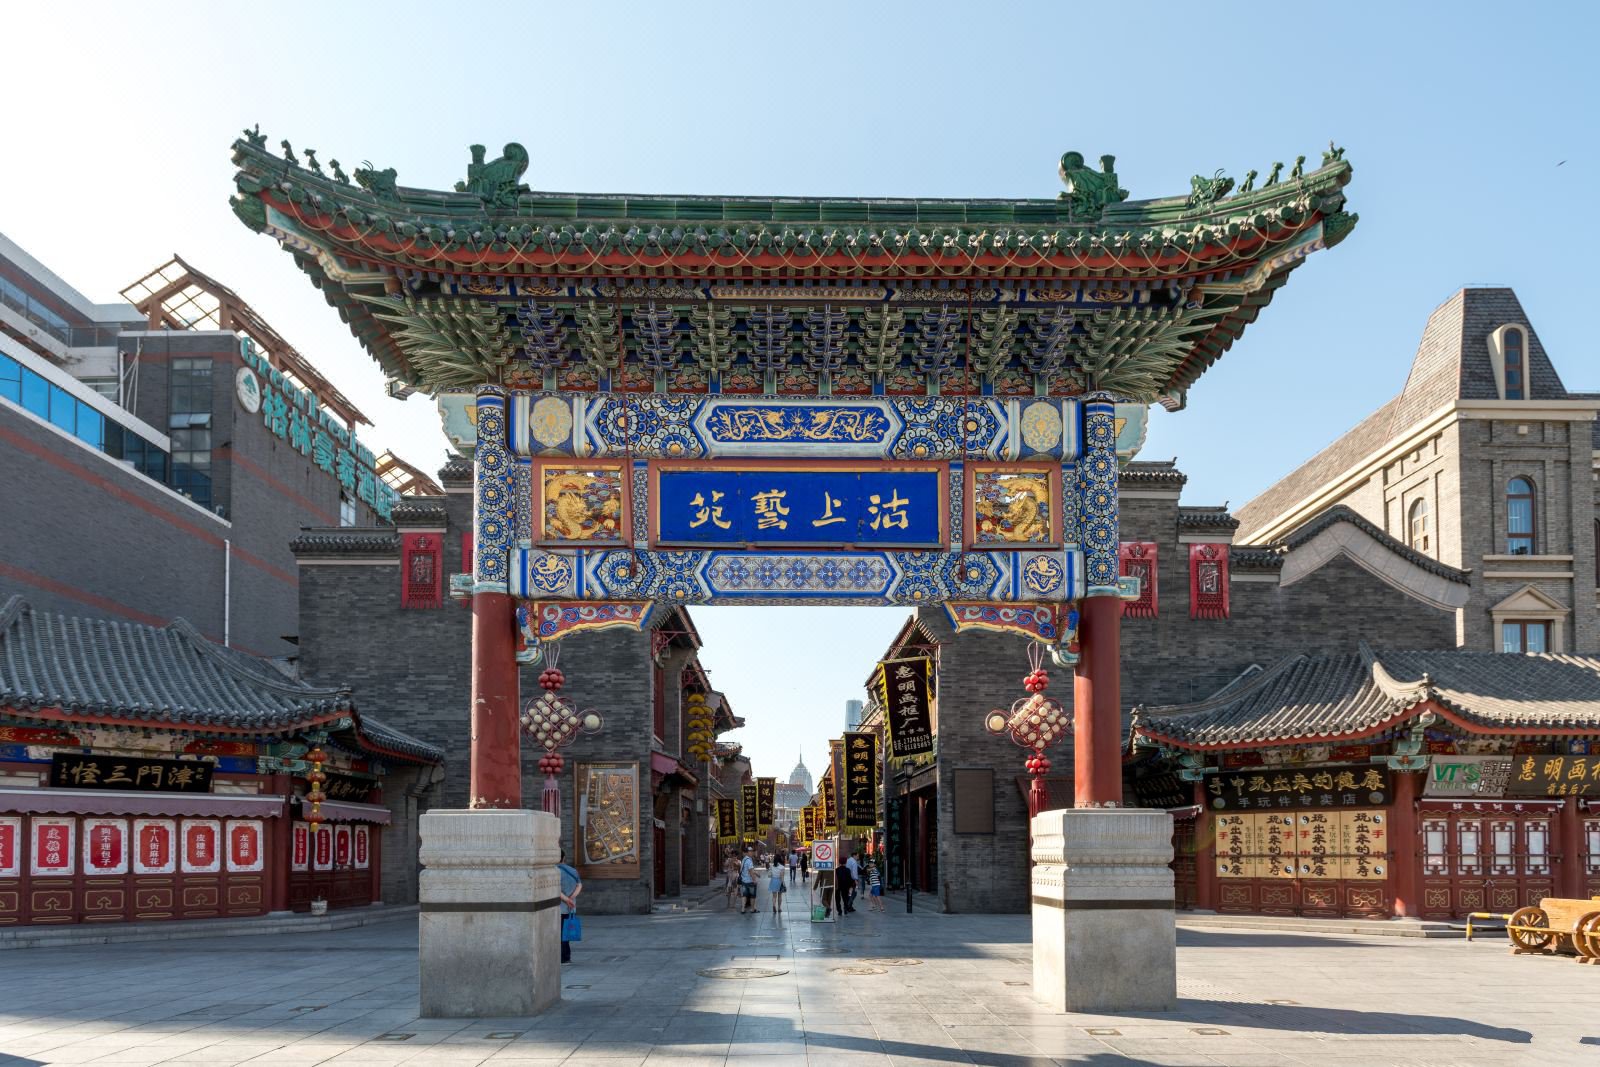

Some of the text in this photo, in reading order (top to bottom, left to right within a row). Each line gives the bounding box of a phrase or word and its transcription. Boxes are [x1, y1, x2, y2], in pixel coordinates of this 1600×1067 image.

[261, 383, 394, 523] 格林豪泰酒店
[895, 665, 919, 729] 惠明画框厂
[851, 738, 870, 796] 惠明画框厂
[100, 827, 112, 866] 狗不理包子
[149, 827, 160, 866] 十八街麻花
